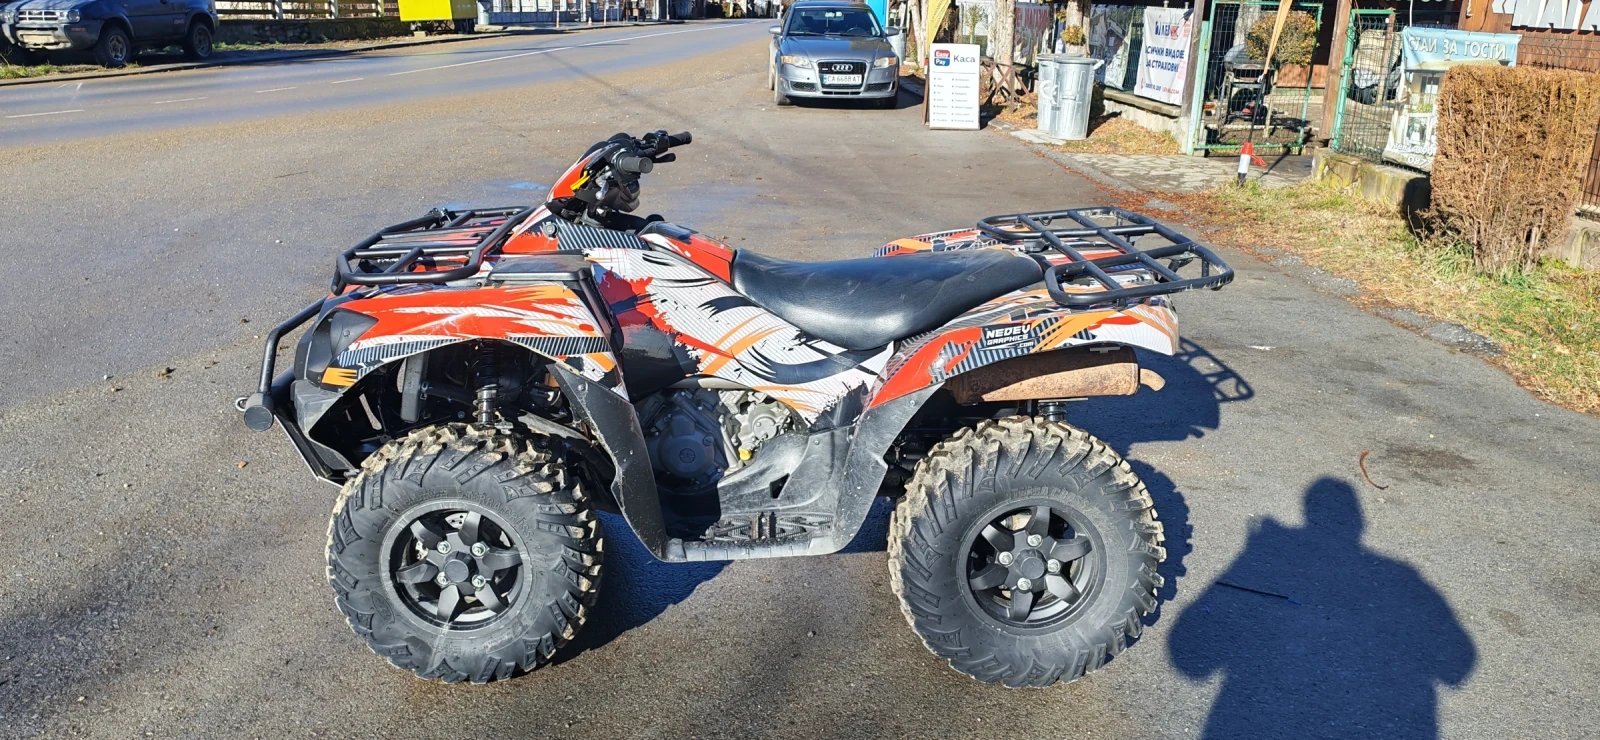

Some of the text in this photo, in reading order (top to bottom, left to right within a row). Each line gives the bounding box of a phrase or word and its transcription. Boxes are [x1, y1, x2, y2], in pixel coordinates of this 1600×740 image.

[1408, 36, 1506, 59] СТАИ ЗА ГОСТИ
[935, 58, 947, 66] Pay
[986, 324, 1031, 338] NEDEV
[986, 333, 1029, 346] GRAPHICS
